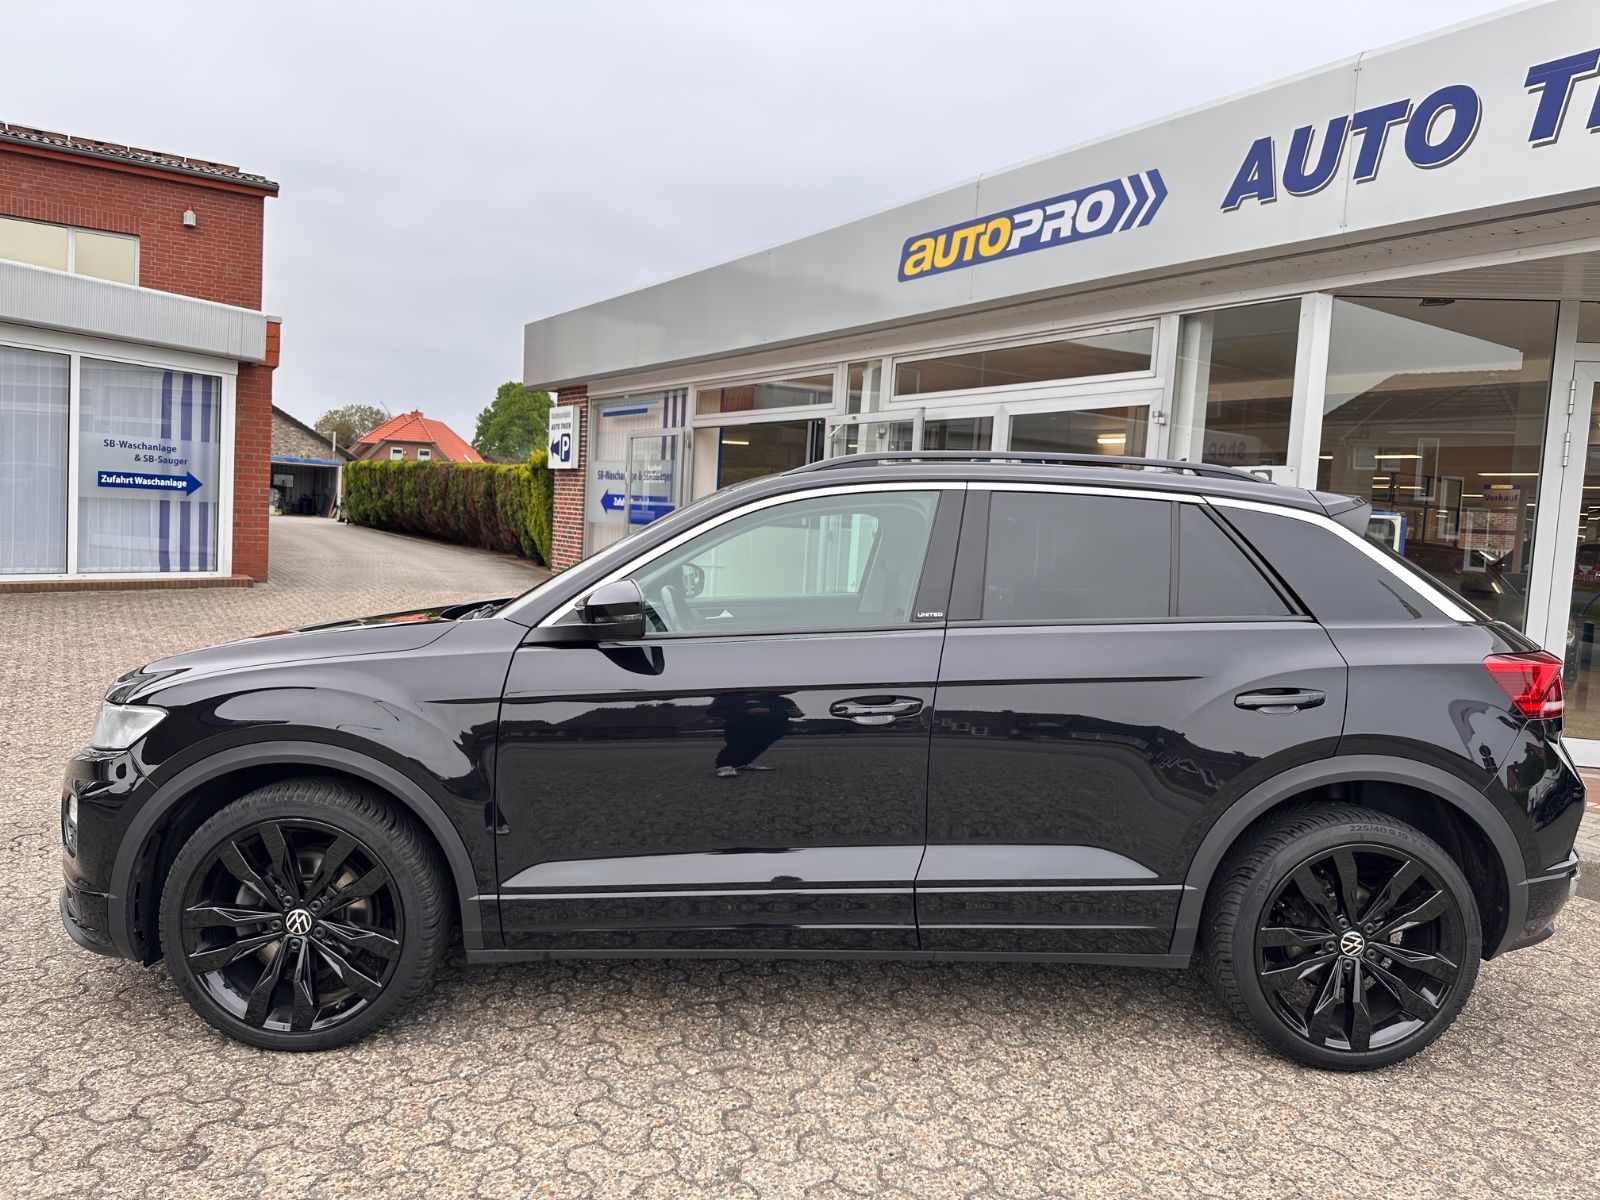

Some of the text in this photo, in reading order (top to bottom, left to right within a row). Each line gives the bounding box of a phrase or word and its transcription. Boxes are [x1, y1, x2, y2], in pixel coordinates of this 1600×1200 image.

[1220, 47, 1600, 213] AUTO T
[103, 439, 177, 453] SB-Waschanlage
[562, 436, 569, 460] P
[134, 453, 188, 466] & SB-Sauger
[101, 474, 187, 488] Zufahrt Waschanlage
[1349, 824, 1388, 835] 225/40
